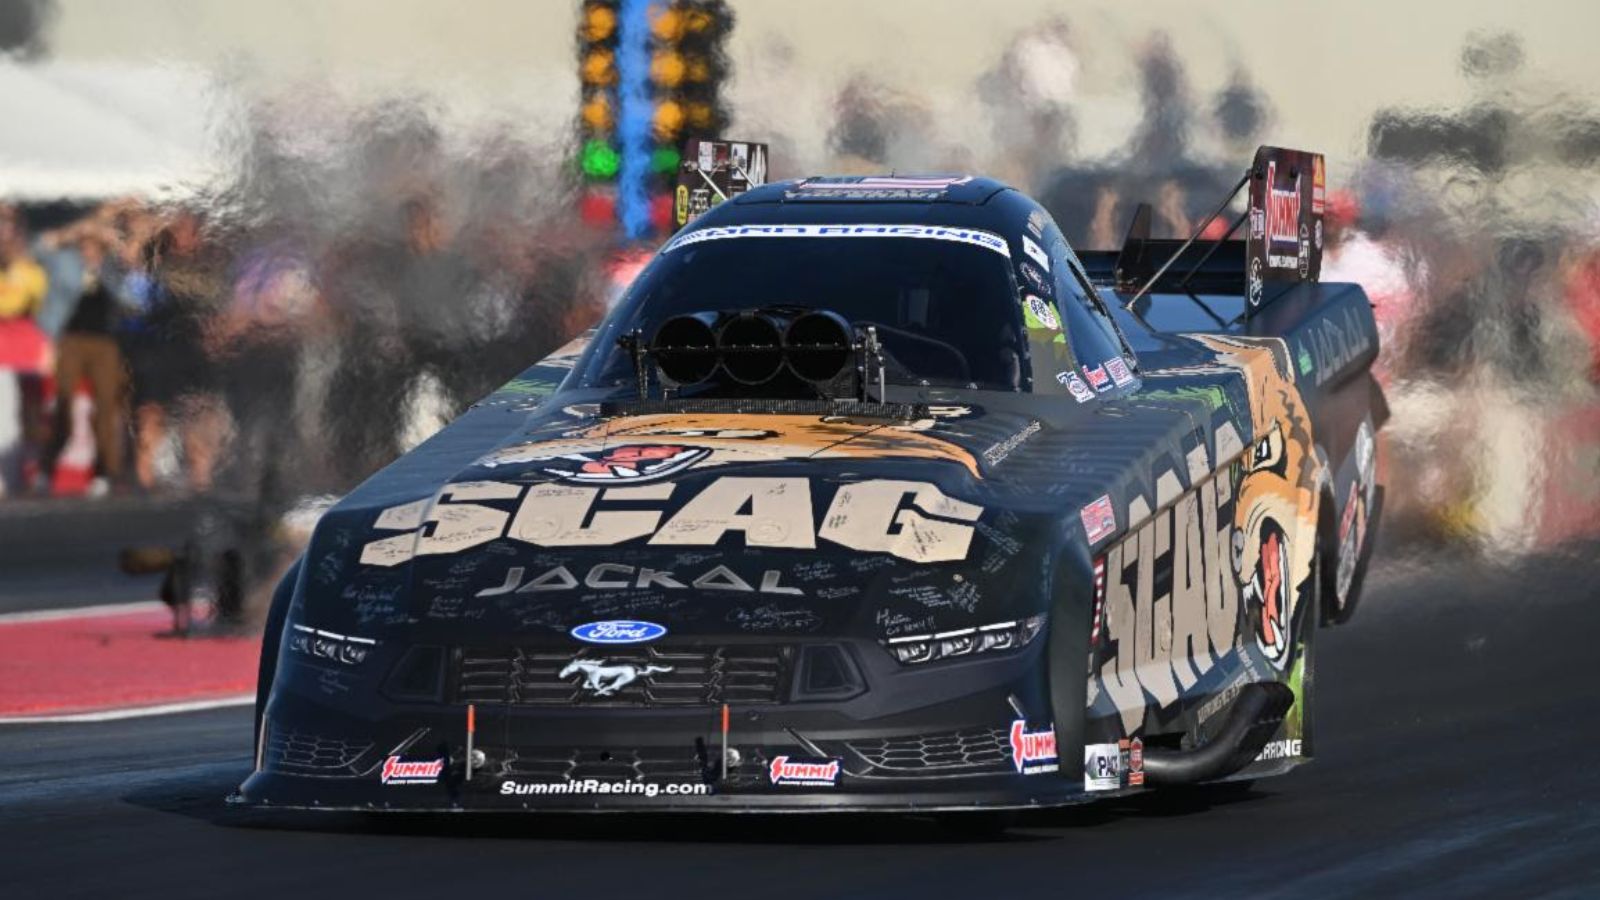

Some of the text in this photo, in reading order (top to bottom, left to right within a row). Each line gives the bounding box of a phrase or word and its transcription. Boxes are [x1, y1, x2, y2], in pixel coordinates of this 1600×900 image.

[359, 477, 984, 566] SCAG
[474, 564, 803, 597] JACKAL
[1101, 421, 1245, 737] SCAG
[588, 621, 649, 638] Ford
[500, 780, 712, 797] SummitRacing.com
